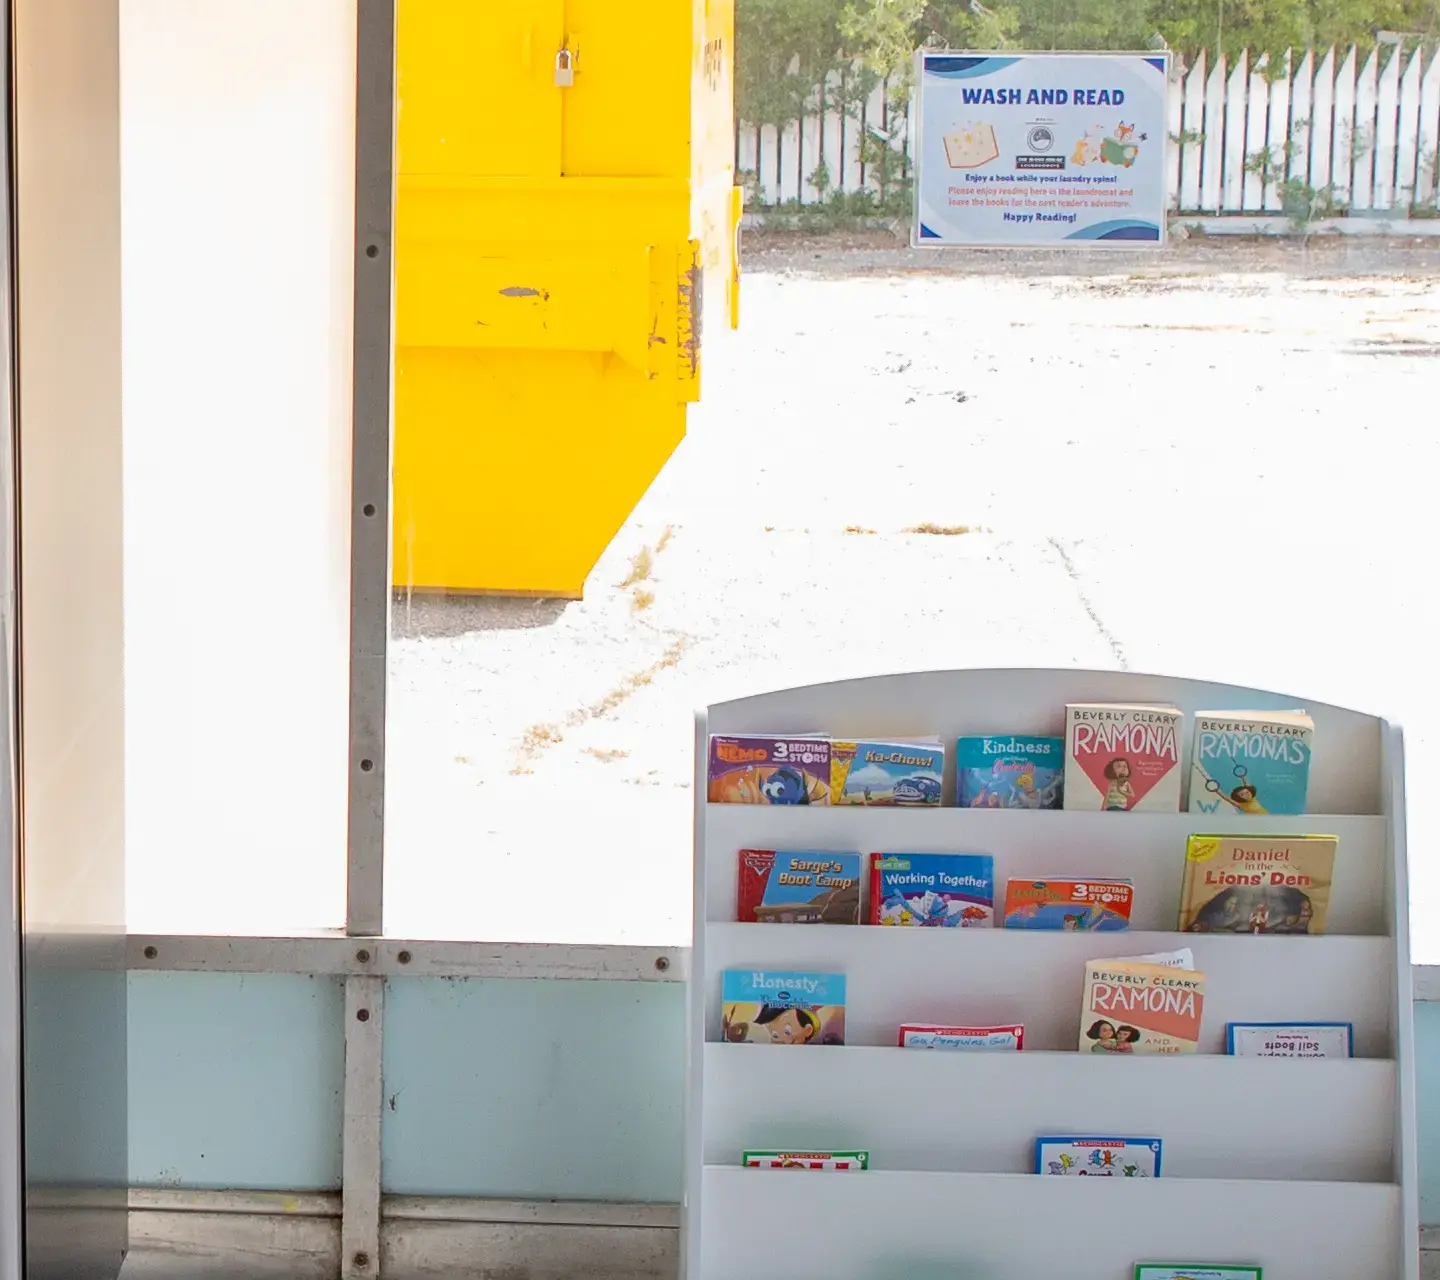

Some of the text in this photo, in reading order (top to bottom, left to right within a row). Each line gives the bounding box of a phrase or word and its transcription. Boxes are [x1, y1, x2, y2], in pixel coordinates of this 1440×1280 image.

[961, 88, 1125, 106] WASH AND READ
[965, 174, 987, 184] Enjoy
[996, 174, 1015, 182] book
[1017, 174, 1037, 182] while
[1040, 175, 1057, 184] your
[1059, 174, 1090, 184] laundry
[1091, 174, 1117, 184] spins!
[948, 187, 974, 195] Please
[976, 188, 997, 197] enjoy
[999, 187, 1028, 197] reading
[1030, 187, 1047, 195] here
[1073, 188, 1117, 196] laundromat
[1119, 188, 1133, 196] and
[948, 198, 969, 207] leave
[971, 198, 984, 206] the
[986, 198, 1009, 206] books
[1011, 198, 1023, 207] for
[1024, 198, 1037, 207] the
[1039, 199, 1056, 207] next
[1058, 198, 1088, 207] reader's
[1003, 213, 1077, 223] Happy Reading!
[1074, 711, 1178, 724] BEVERLY CLEARY
[1202, 722, 1306, 737] BEVERLY CLEARY
[982, 739, 1051, 755] Kindness
[1073, 723, 1178, 761] RAMONA
[716, 745, 768, 762] NEMO
[773, 742, 828, 758] 3 BEDTIME
[789, 752, 828, 764] STORY
[865, 750, 933, 767] Ka-Chow!
[1232, 847, 1290, 861] Daniel
[789, 859, 842, 874] Sarge's
[1245, 862, 1274, 870] in the
[778, 873, 853, 890] Boot Camp
[886, 872, 988, 888] Working Together
[1205, 871, 1312, 886] Lions' Den
[1072, 884, 1129, 897] 3 BEDTIME
[1088, 894, 1128, 903] STORY
[752, 973, 819, 993] Honesty
[1092, 972, 1199, 989] BEVERLY CLEARY
[1091, 983, 1196, 1018] RAMONA
[989, 1035, 1012, 1045] Go!
[1144, 1038, 1170, 1046] AND
[1265, 1041, 1319, 1051] Sail Boats
